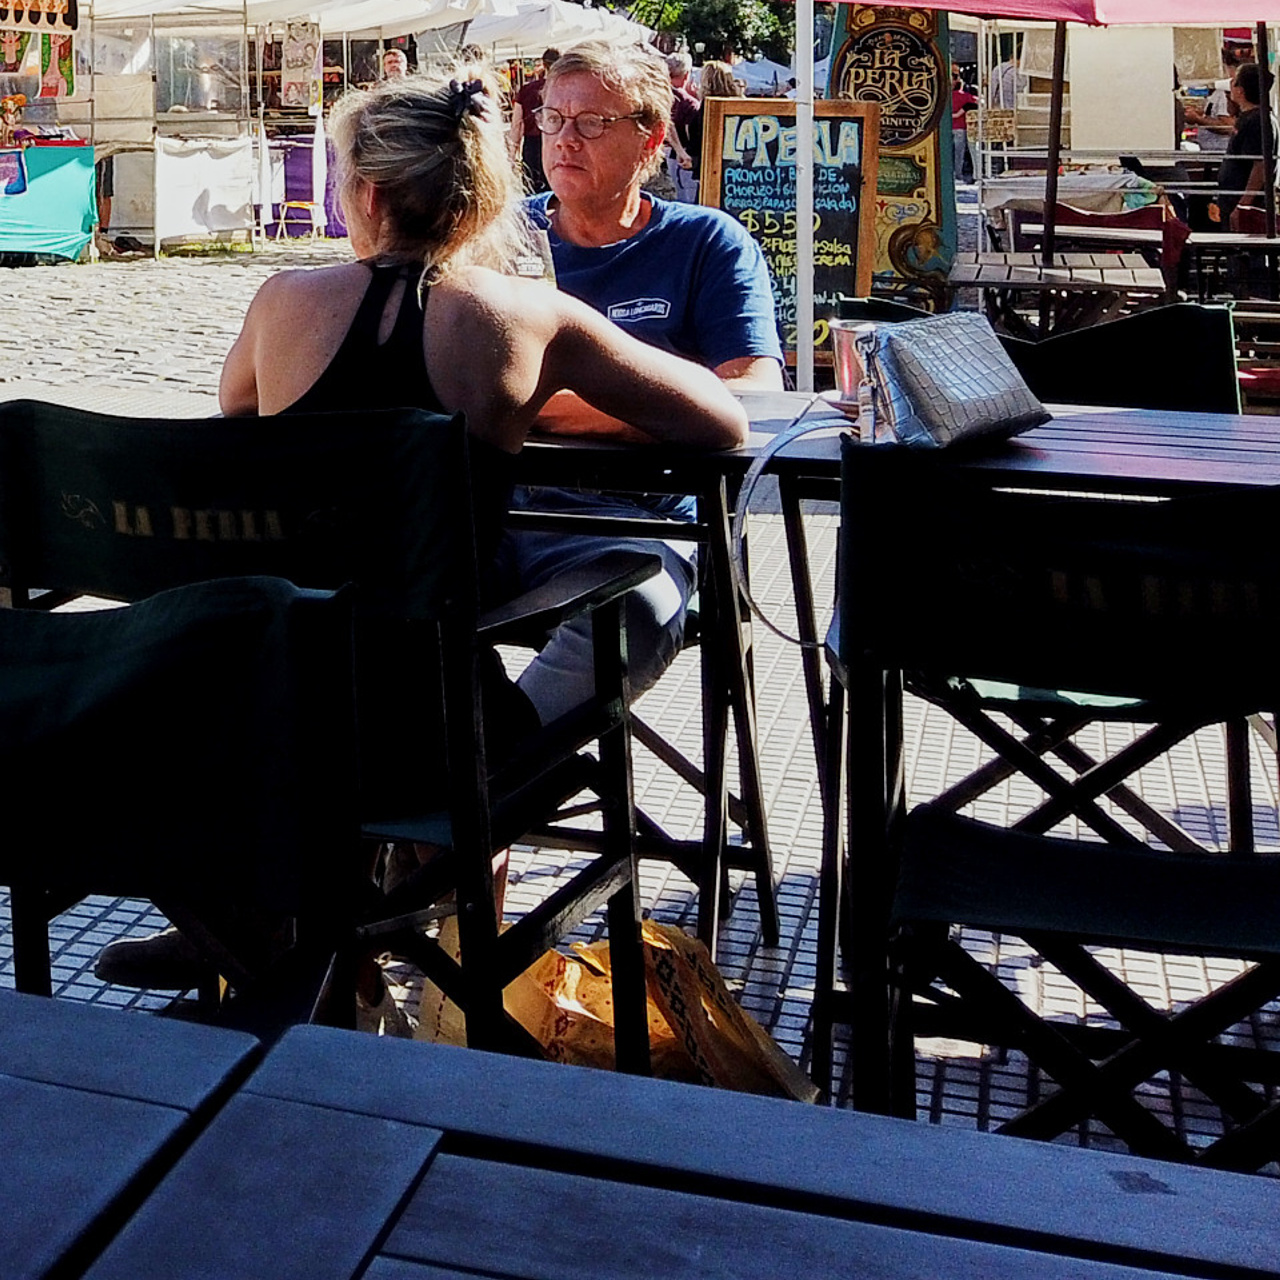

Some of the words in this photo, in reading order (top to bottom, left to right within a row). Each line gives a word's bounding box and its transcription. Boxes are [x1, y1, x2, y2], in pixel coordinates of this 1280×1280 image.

[874, 49, 902, 70] LA
[849, 68, 932, 97] PERLA
[723, 116, 756, 161] LA
